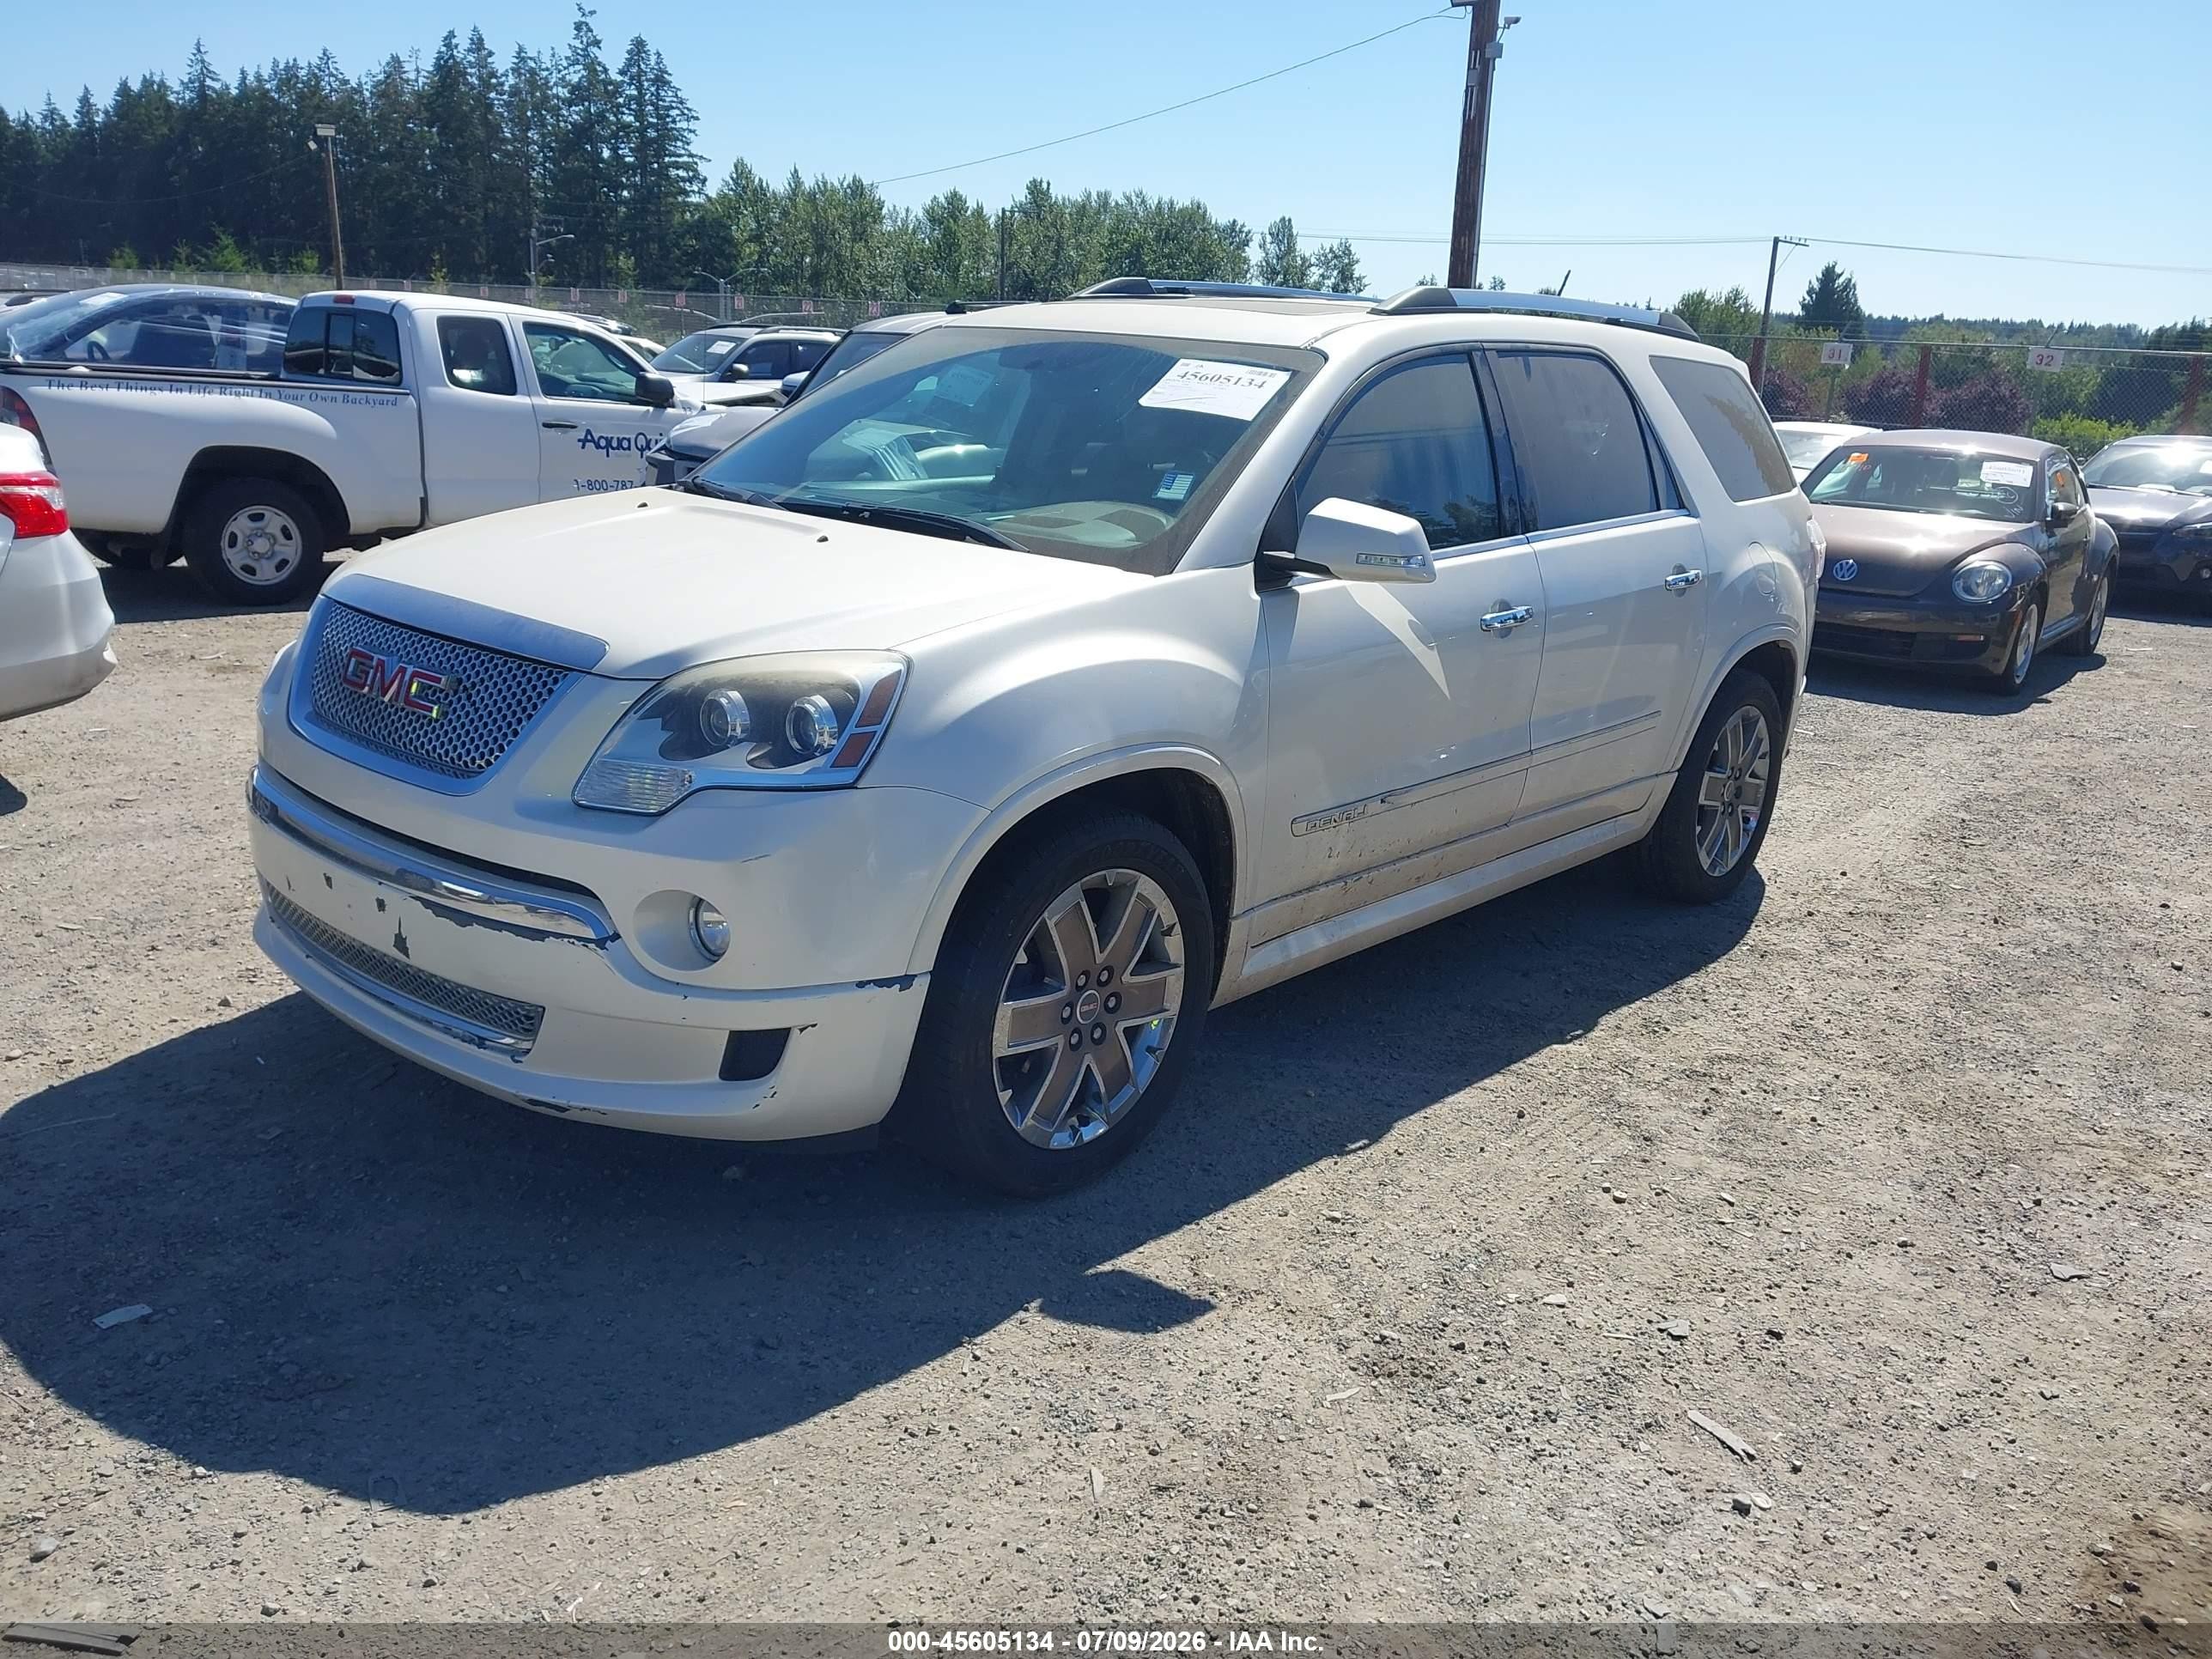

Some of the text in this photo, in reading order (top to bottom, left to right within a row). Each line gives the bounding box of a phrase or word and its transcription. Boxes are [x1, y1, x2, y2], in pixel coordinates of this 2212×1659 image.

[1827, 348, 1842, 360] 31
[2035, 353, 2054, 367] 32
[46, 379, 398, 408] The Best Things In Life Right In Your Own Backyard
[1176, 370, 1268, 389] 45605134
[577, 428, 632, 458] Aqua
[343, 646, 448, 720] GMC
[1305, 804, 1367, 832] DENALI
